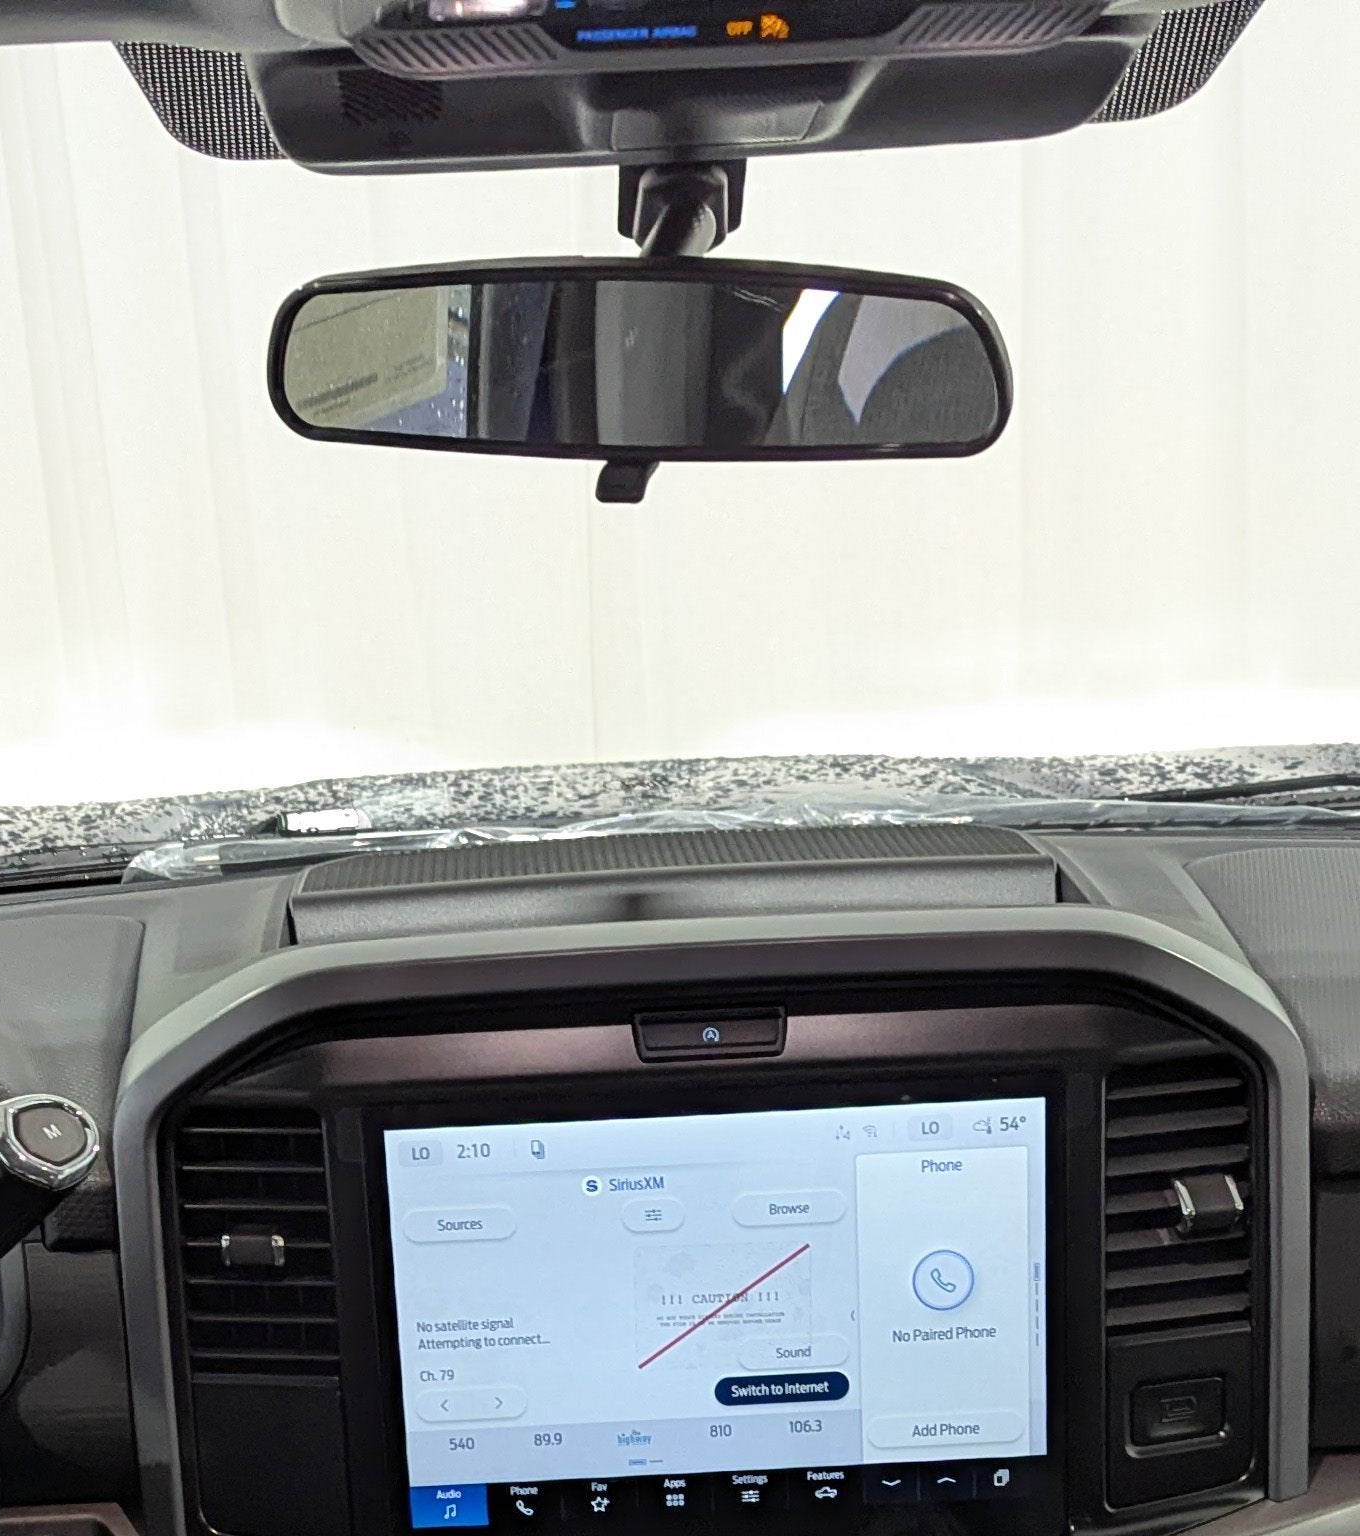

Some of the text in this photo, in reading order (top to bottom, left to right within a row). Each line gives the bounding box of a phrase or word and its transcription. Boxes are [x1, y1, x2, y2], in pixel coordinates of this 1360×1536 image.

[921, 1121, 940, 1135] LO
[999, 1116, 1027, 1132] 54°
[42, 1124, 62, 1140] M
[411, 1147, 430, 1160] LO
[457, 1143, 491, 1159] 2:10
[921, 1159, 963, 1173] Phone
[609, 1176, 665, 1192] SiriusXM
[769, 1203, 810, 1216] Browse
[437, 1219, 483, 1232] Sources
[416, 1317, 514, 1334] No satellite signal
[892, 1326, 997, 1343] No Paired Phone
[418, 1337, 482, 1351] Attempting
[484, 1336, 497, 1347] to
[776, 1346, 812, 1359] Sound
[420, 1369, 455, 1383] Ch. 79
[731, 1381, 829, 1398] Switch to Internet
[709, 1424, 732, 1437] 810
[789, 1419, 822, 1433] 106.3
[912, 1423, 980, 1438] Add Phone
[449, 1437, 475, 1451] 540
[533, 1432, 563, 1447] 89.9
[732, 1474, 768, 1486] Settings
[807, 1470, 845, 1481] Features
[510, 1485, 538, 1497] Phone
[591, 1482, 608, 1493] Fav
[663, 1478, 687, 1490] Apps
[436, 1489, 462, 1500] Audio
